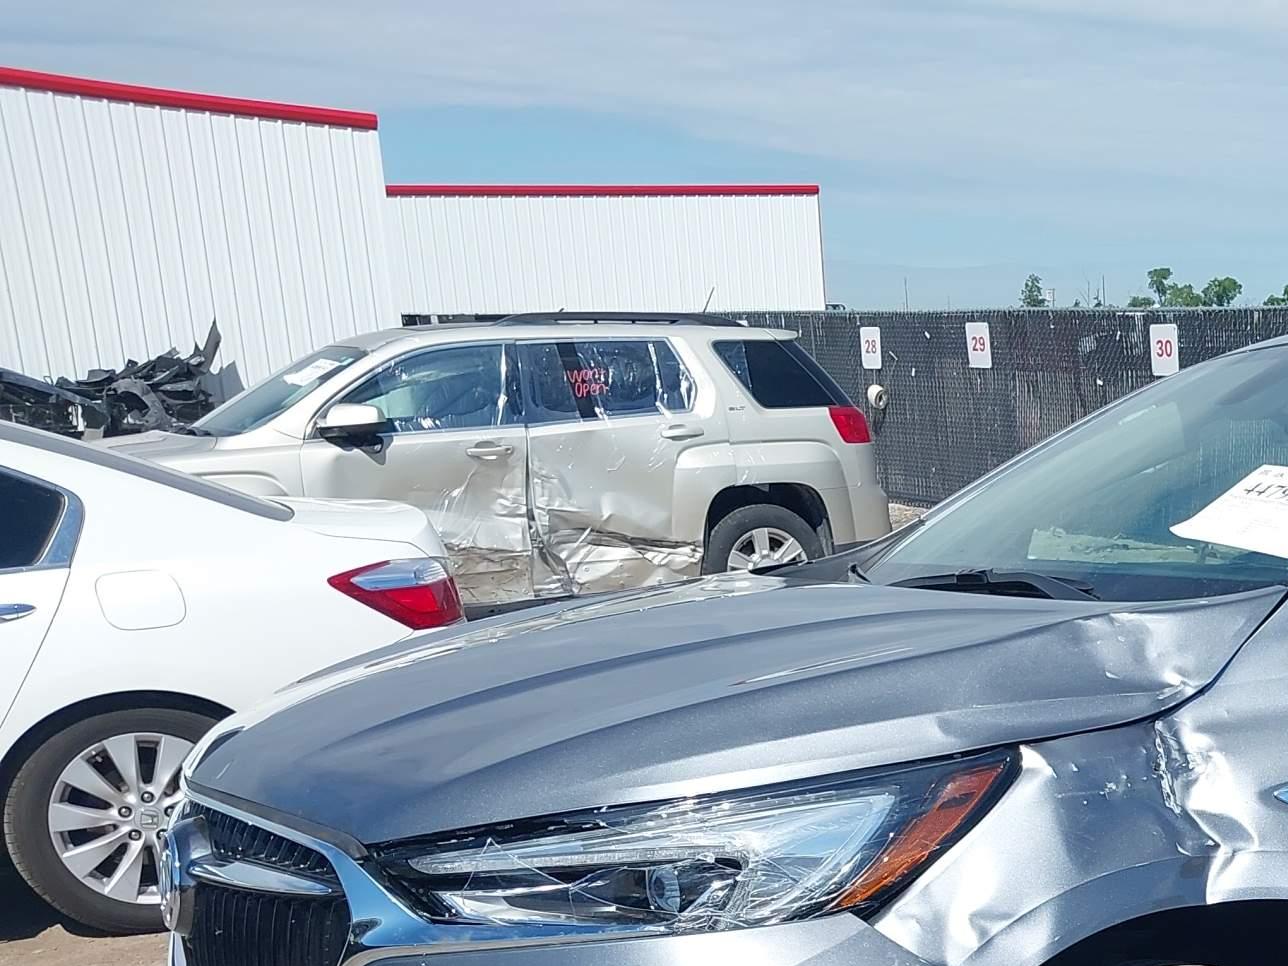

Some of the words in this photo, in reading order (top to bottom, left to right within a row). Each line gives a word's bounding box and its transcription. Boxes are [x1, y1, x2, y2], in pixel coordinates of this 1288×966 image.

[864, 339, 877, 354] 28
[971, 336, 986, 352] 29
[1156, 339, 1173, 358] 30
